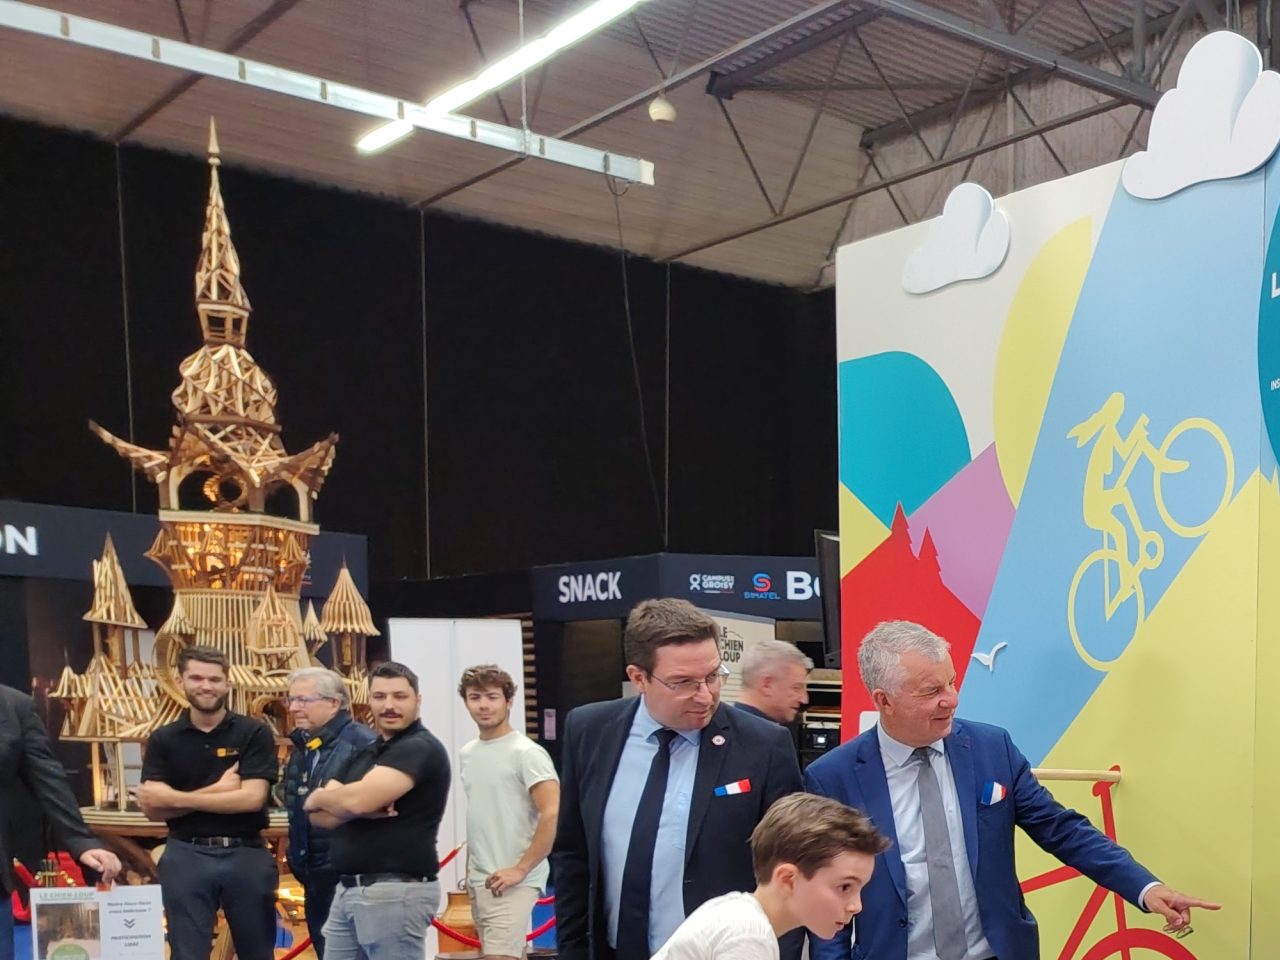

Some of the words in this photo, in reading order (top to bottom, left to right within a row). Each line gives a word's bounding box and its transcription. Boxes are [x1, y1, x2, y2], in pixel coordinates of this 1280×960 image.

[0, 523, 39, 556] N
[558, 571, 622, 603] SNACK
[786, 570, 820, 600] B
[720, 639, 744, 653] CHIEN
[720, 651, 741, 663] LOUP
